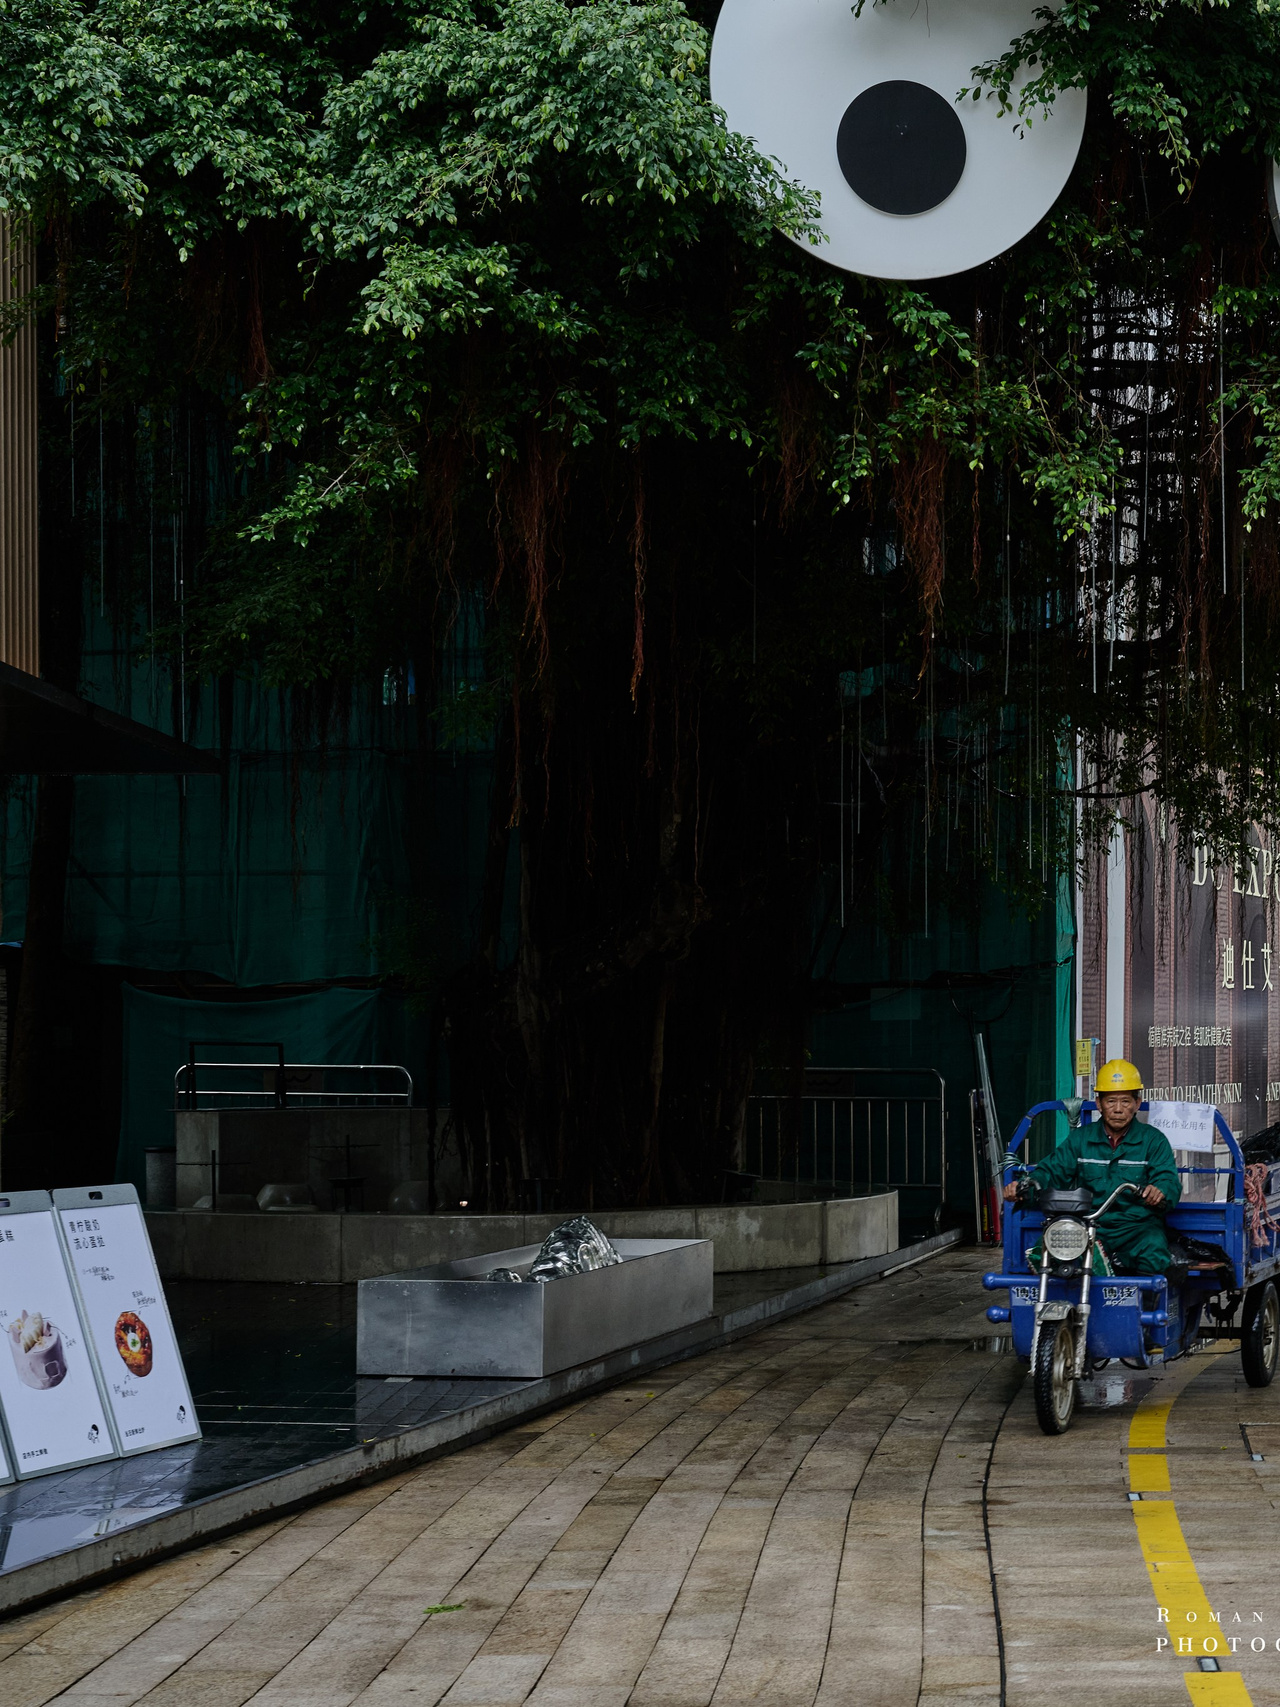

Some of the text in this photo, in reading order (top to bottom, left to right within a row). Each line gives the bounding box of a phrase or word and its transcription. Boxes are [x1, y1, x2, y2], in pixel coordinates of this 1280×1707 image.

[1140, 1087, 1169, 1102] HEERS
[1172, 1086, 1184, 1101] TO
[1223, 1082, 1242, 1104] SKIN!
[1153, 1118, 1207, 1132] 绿化作业用车
